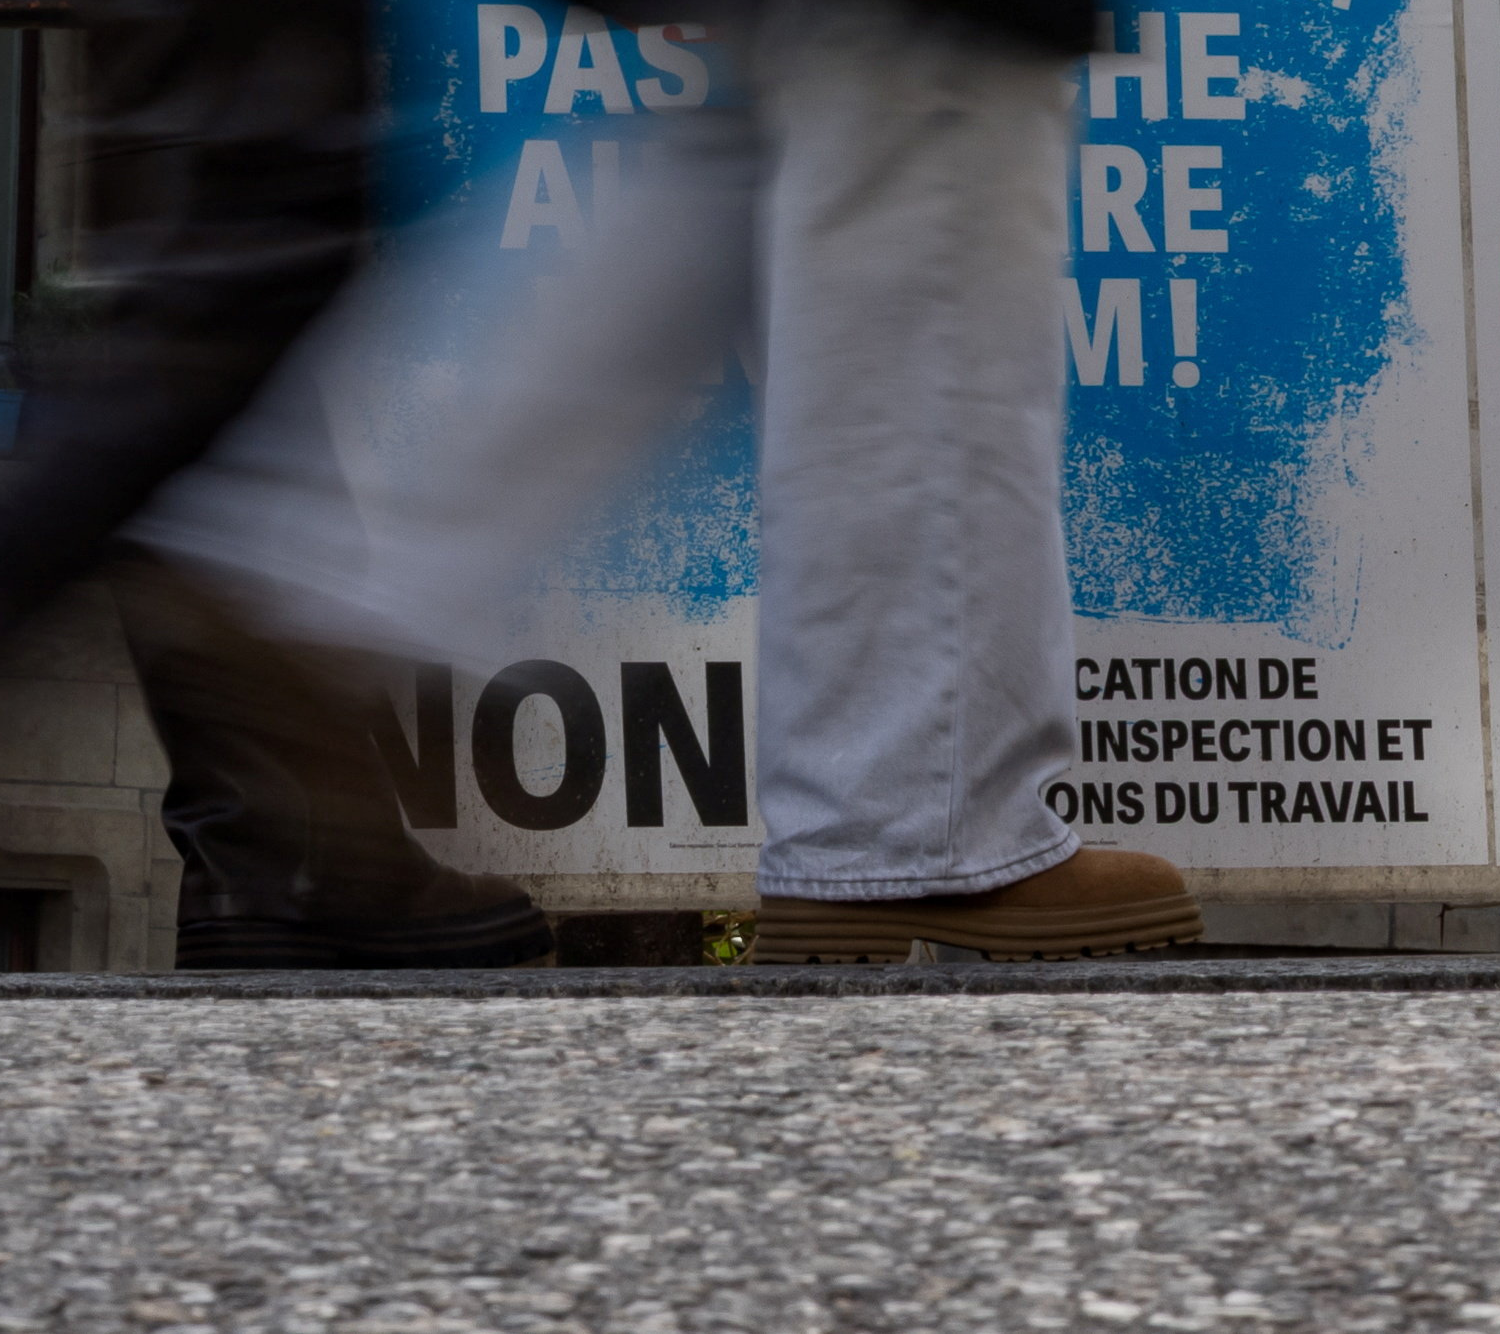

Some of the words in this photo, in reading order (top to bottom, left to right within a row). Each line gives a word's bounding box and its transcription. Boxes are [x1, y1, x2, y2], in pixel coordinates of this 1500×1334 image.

[477, 3, 709, 115] PAS
[1075, 658, 1248, 701] CATION
[1259, 658, 1319, 700] DE
[1376, 719, 1432, 761] ET
[1045, 781, 1145, 825] ONS
[1155, 781, 1220, 825] DU
[1228, 780, 1429, 824] TRAVAIL
